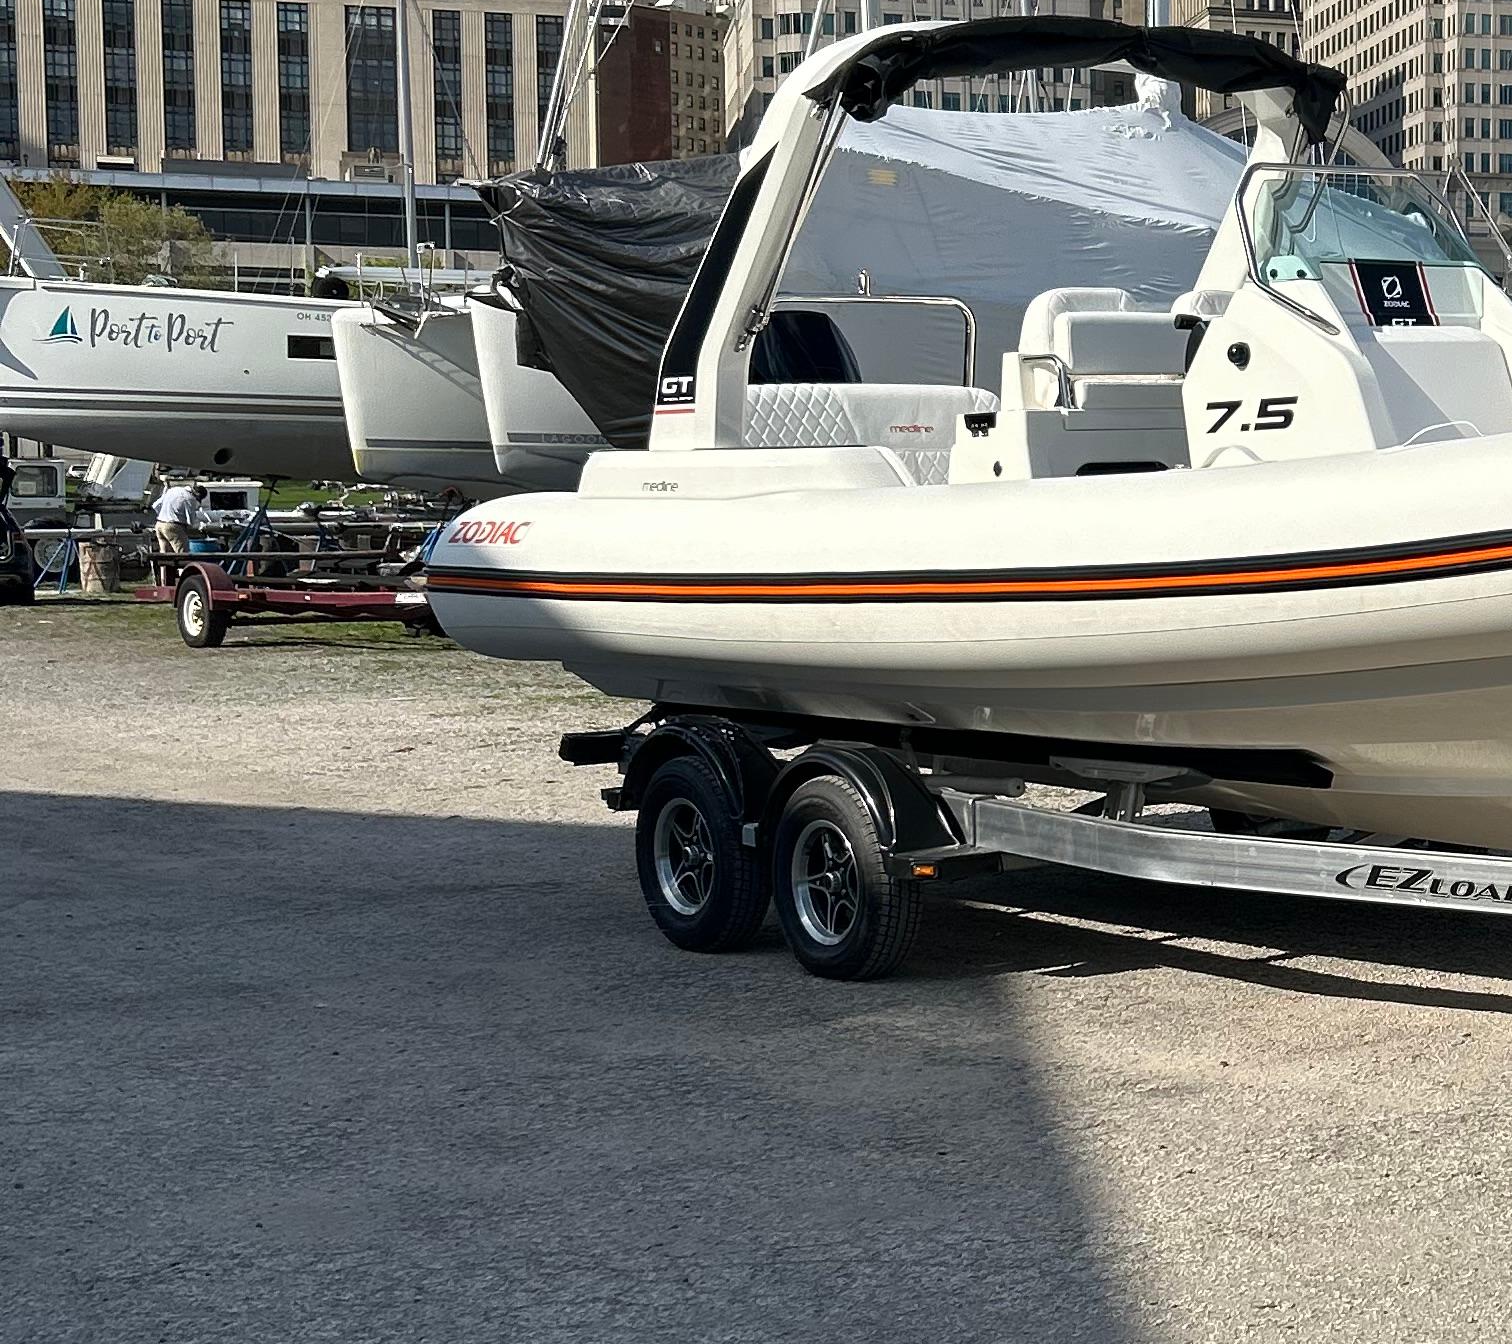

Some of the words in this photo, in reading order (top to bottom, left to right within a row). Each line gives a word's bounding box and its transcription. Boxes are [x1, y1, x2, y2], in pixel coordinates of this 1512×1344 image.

[296, 312, 312, 321] OH
[89, 307, 159, 349] Port
[146, 323, 162, 344] to
[167, 311, 235, 353] Port
[662, 376, 694, 394] GT
[1205, 395, 1299, 435] 7.5
[448, 520, 534, 545] ZODIAC
